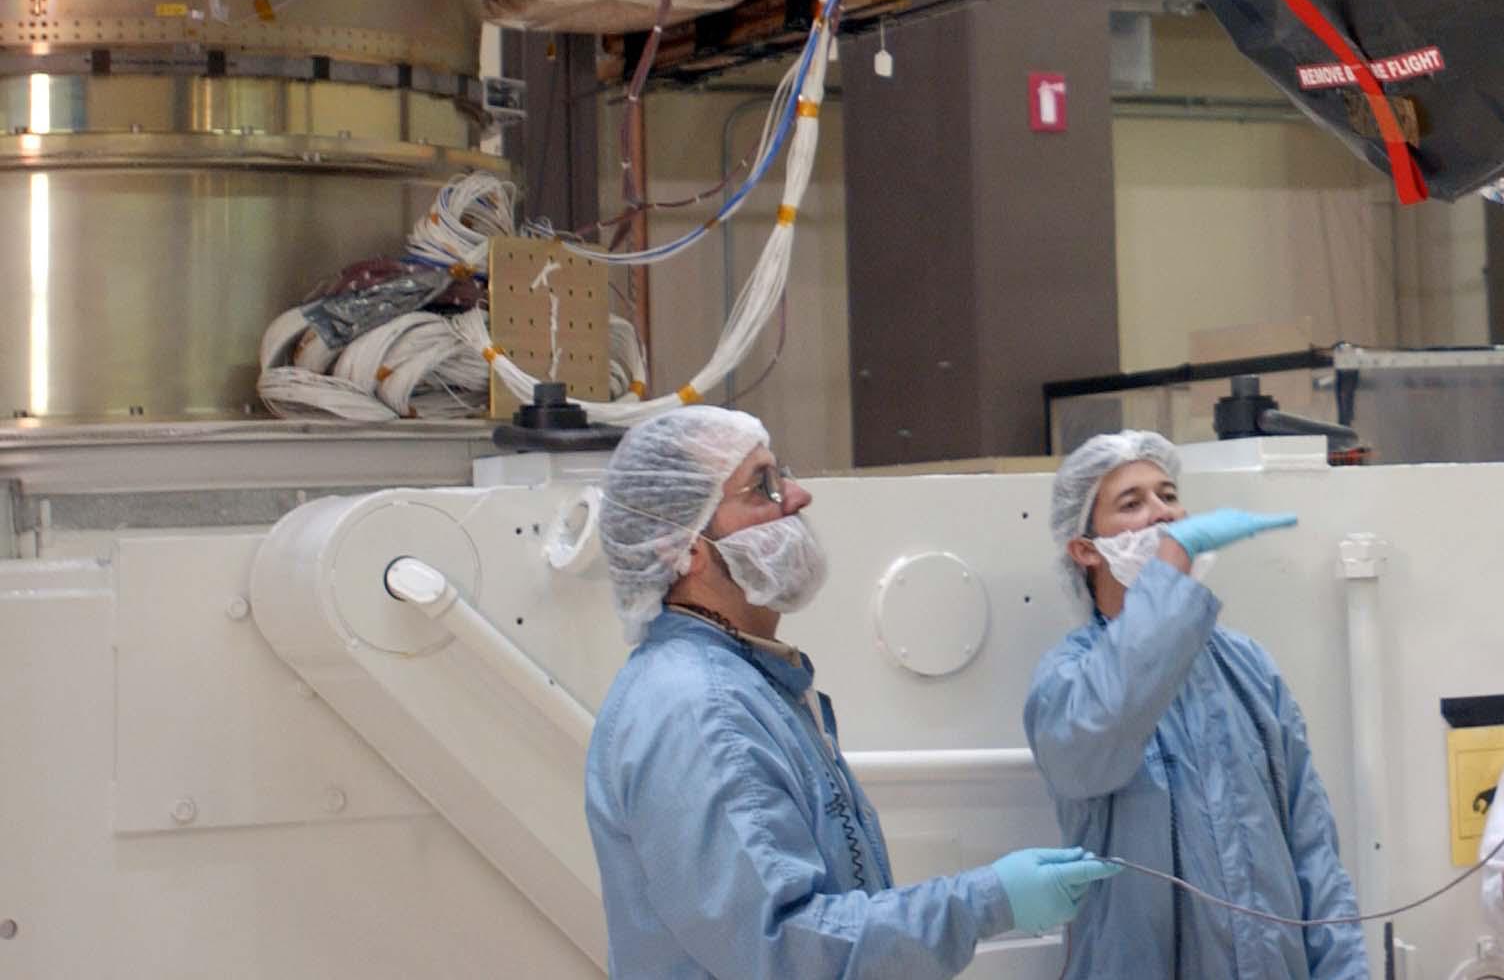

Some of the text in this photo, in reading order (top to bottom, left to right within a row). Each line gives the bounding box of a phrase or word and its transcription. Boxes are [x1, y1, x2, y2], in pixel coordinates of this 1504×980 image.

[1299, 49, 1442, 86] REMOVE BRE FLIGHT
